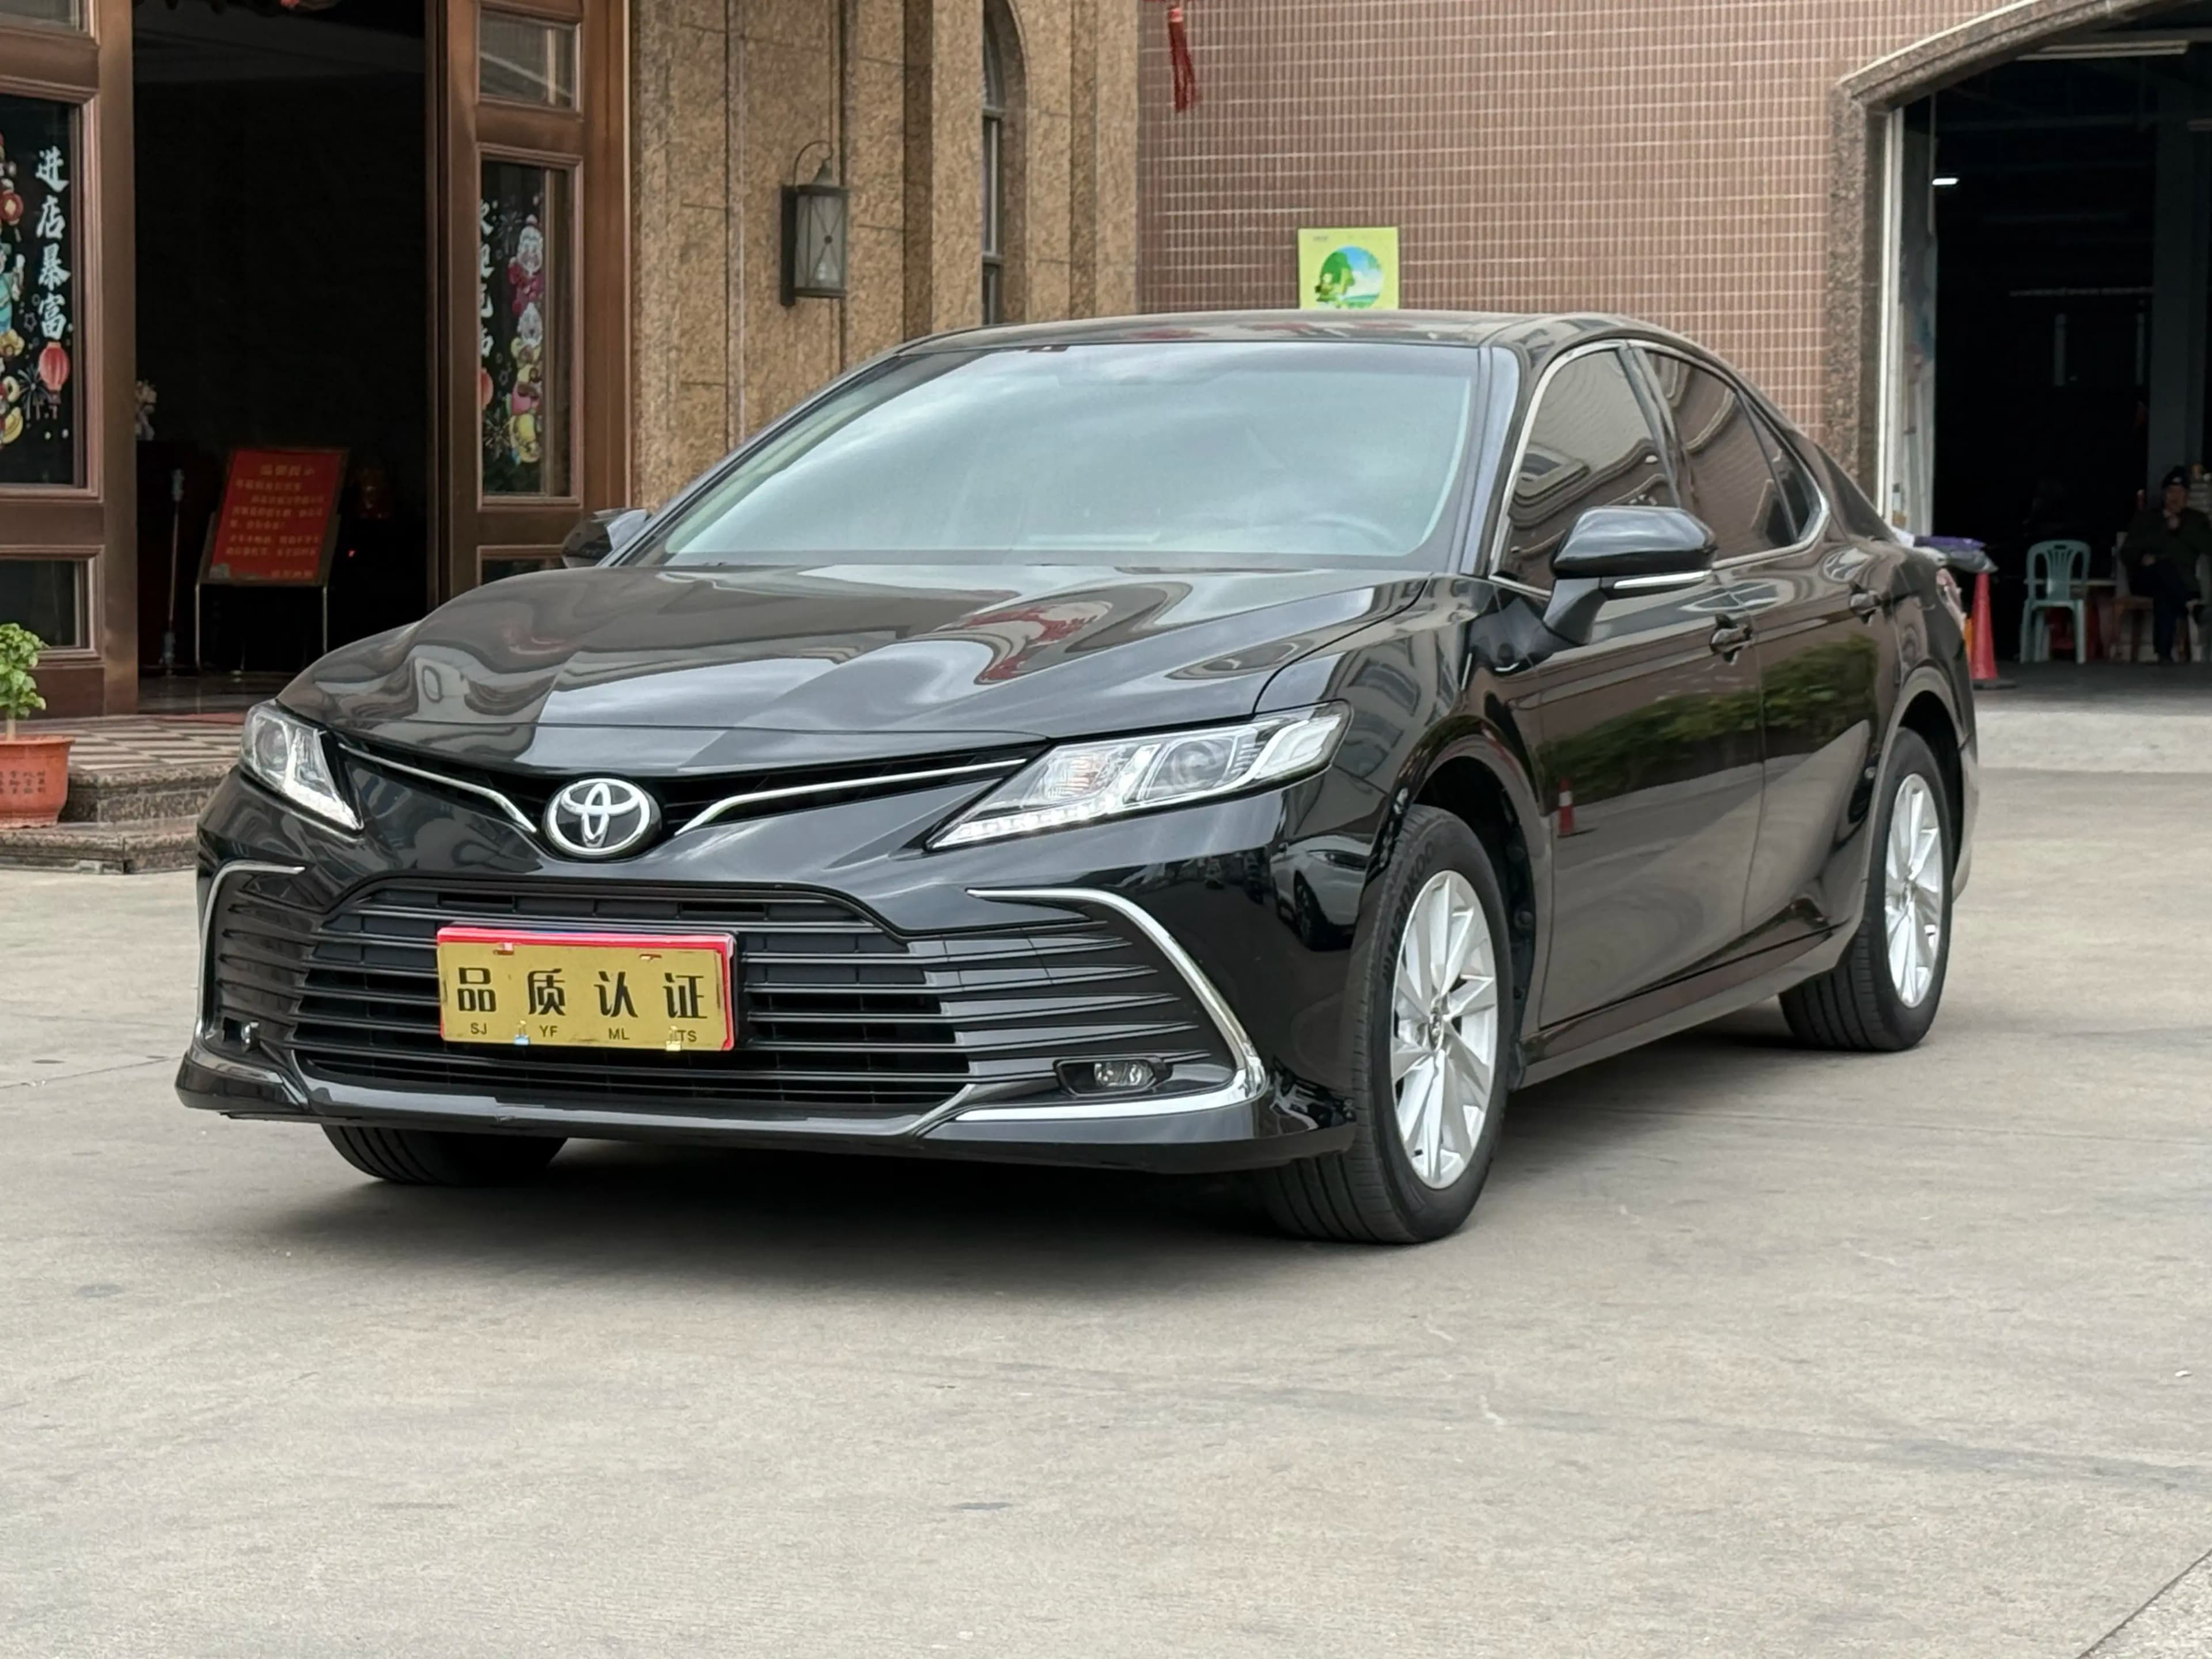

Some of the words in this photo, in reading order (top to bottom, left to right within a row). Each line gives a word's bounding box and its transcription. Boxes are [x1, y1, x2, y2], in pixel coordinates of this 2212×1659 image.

[36, 146, 70, 340] 进店暴富
[457, 967, 708, 1019] 品质认证
[471, 1022, 488, 1035] SJ
[539, 1025, 558, 1037] YF
[609, 1028, 630, 1040] ML
[676, 1029, 697, 1042] TS
